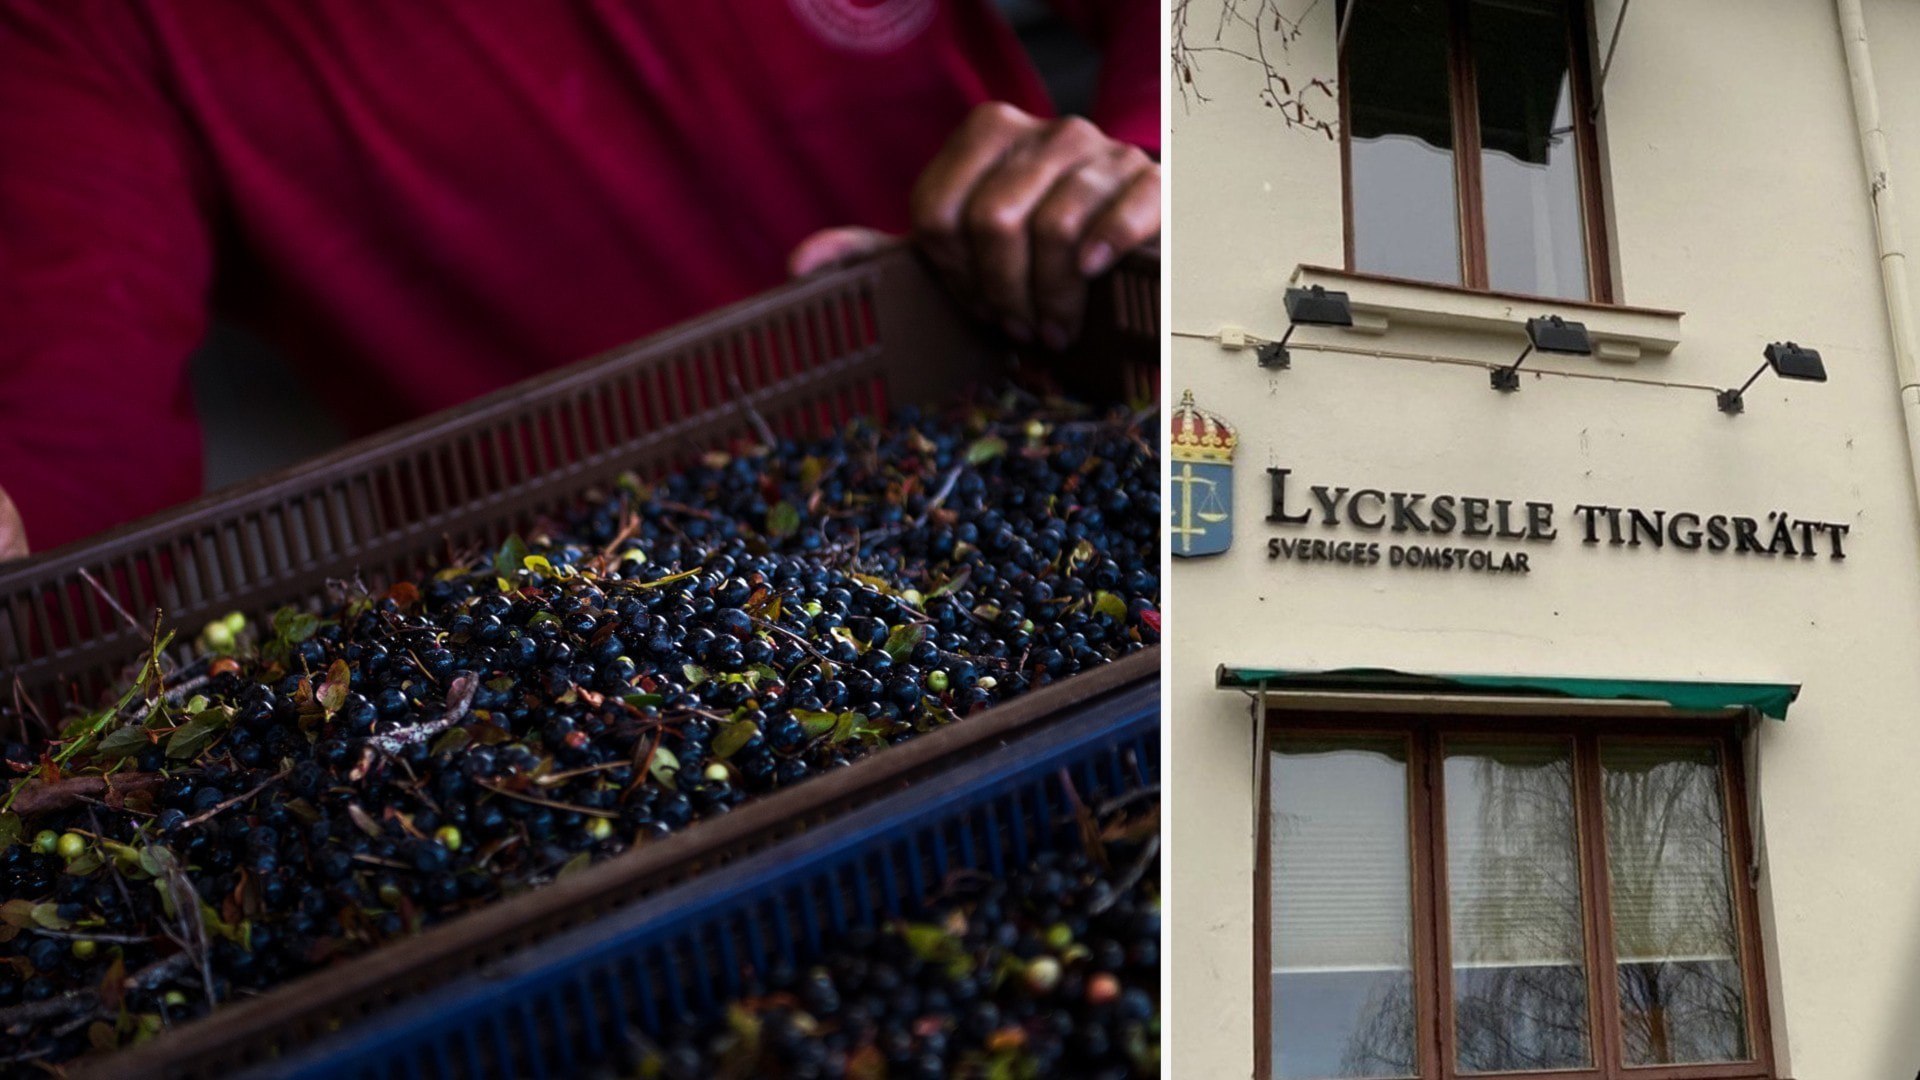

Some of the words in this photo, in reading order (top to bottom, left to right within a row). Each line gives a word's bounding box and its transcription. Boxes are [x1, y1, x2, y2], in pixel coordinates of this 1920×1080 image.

[1266, 467, 1557, 541] LYCKSELE
[1575, 504, 1849, 559] TINGSRÄTT
[1268, 537, 1380, 564] SVERIGES
[1389, 545, 1531, 573] DOMSTOLAR
